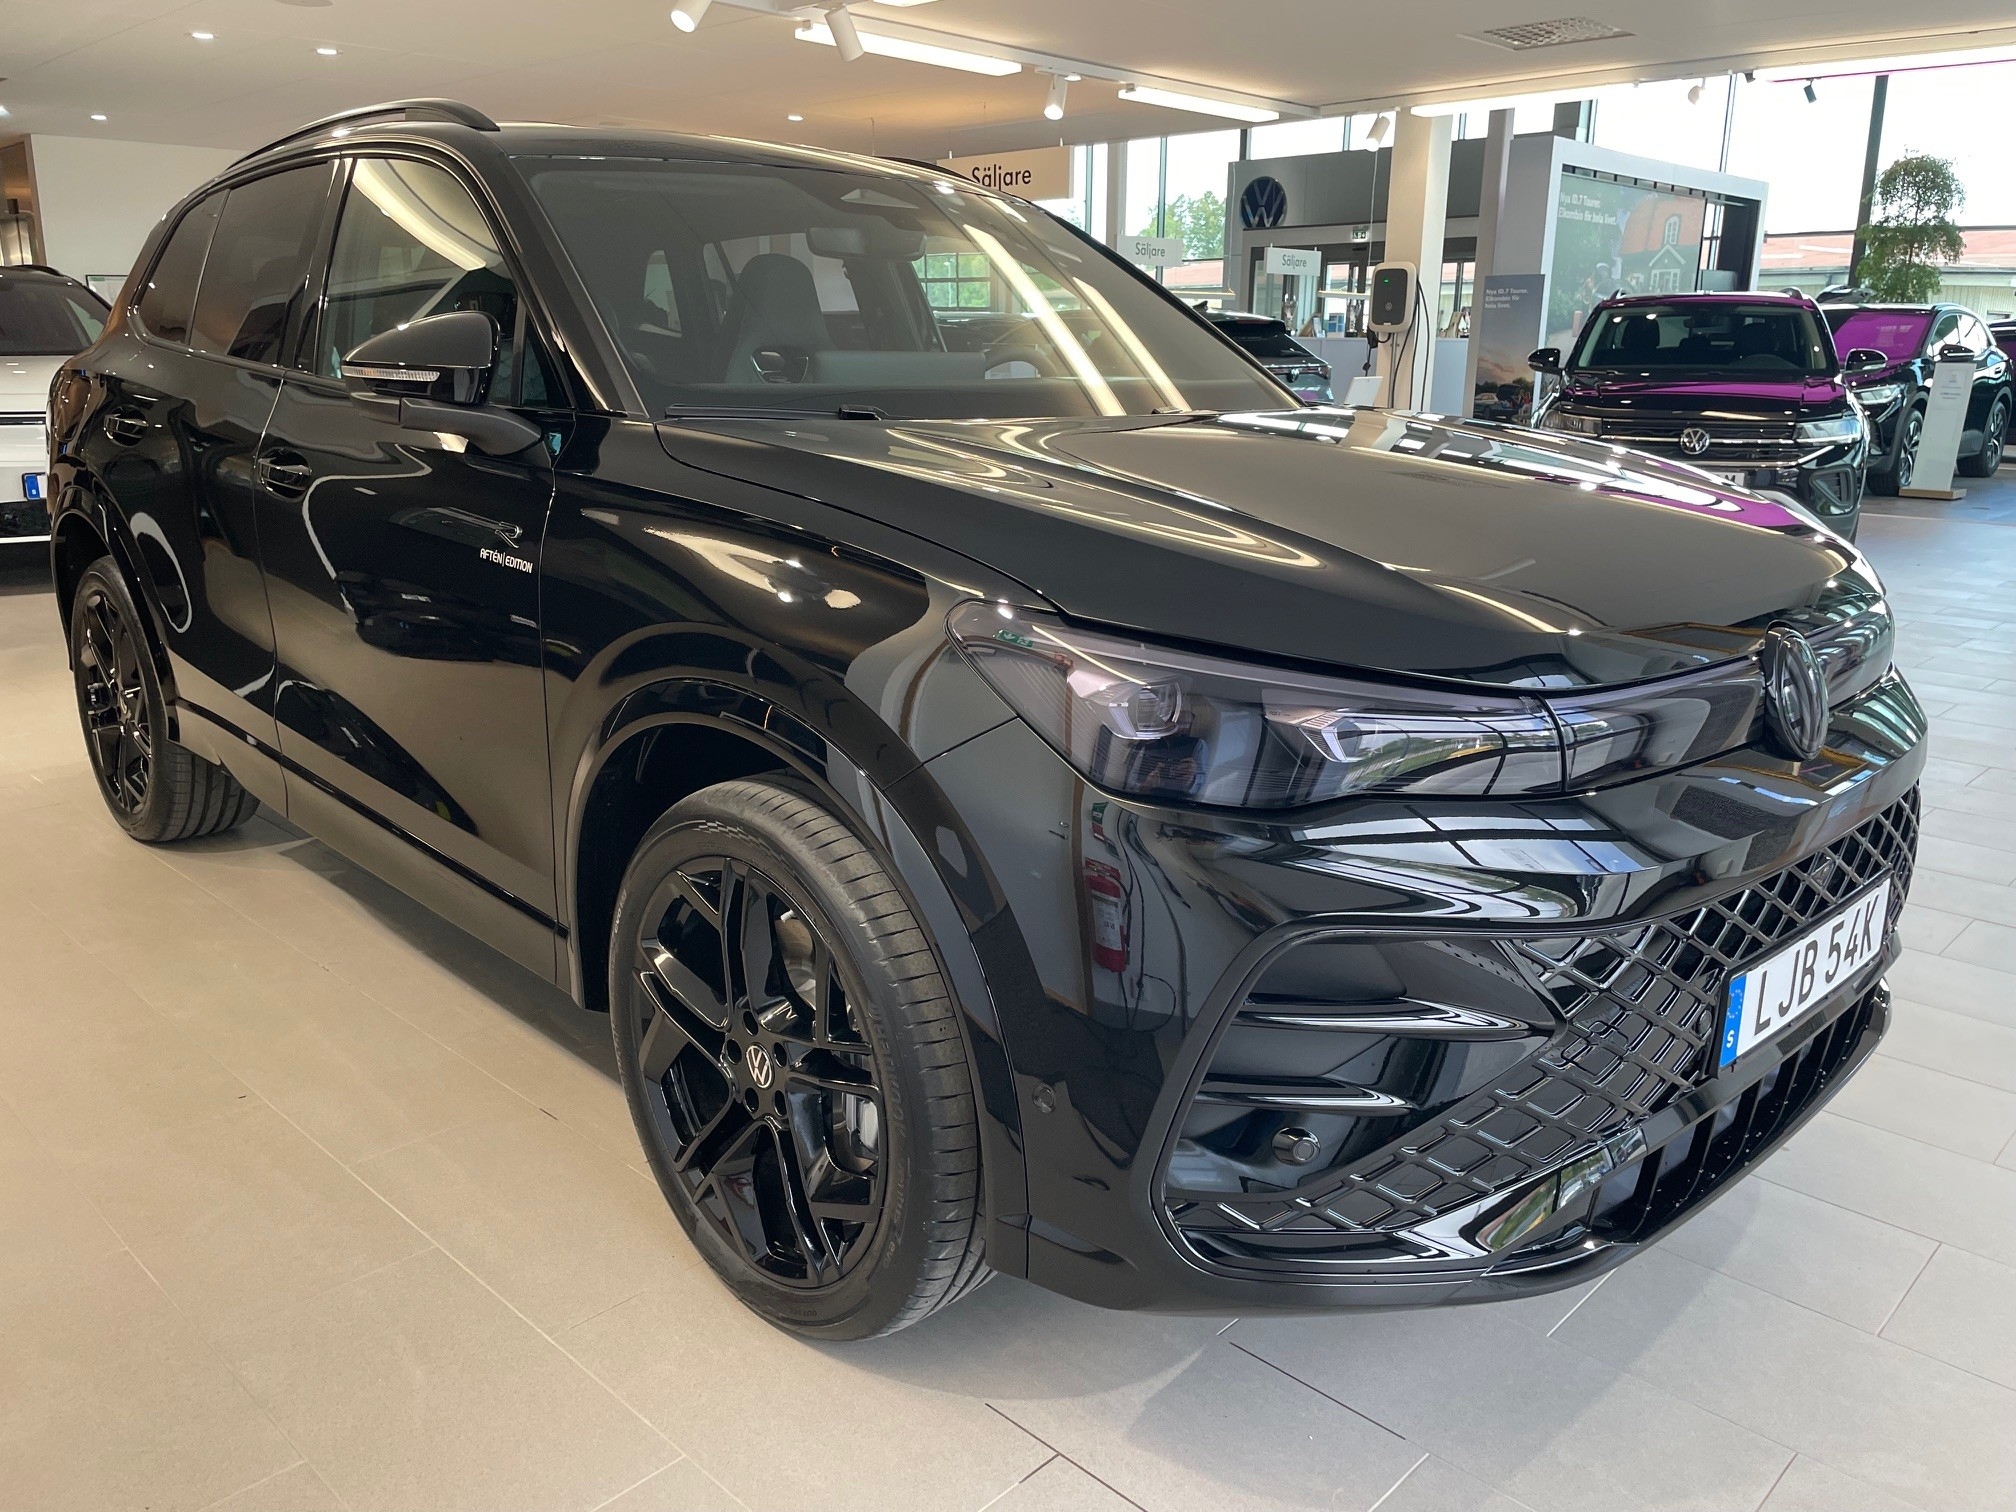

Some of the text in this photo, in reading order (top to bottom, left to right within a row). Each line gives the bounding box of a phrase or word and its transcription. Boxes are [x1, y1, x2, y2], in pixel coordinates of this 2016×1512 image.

[972, 164, 1032, 191] Säljare
[1135, 242, 1166, 259] Säljare
[1281, 254, 1307, 269] Säljare
[1754, 892, 1880, 1037] LJB 54K
[1726, 1029, 1735, 1048] S
